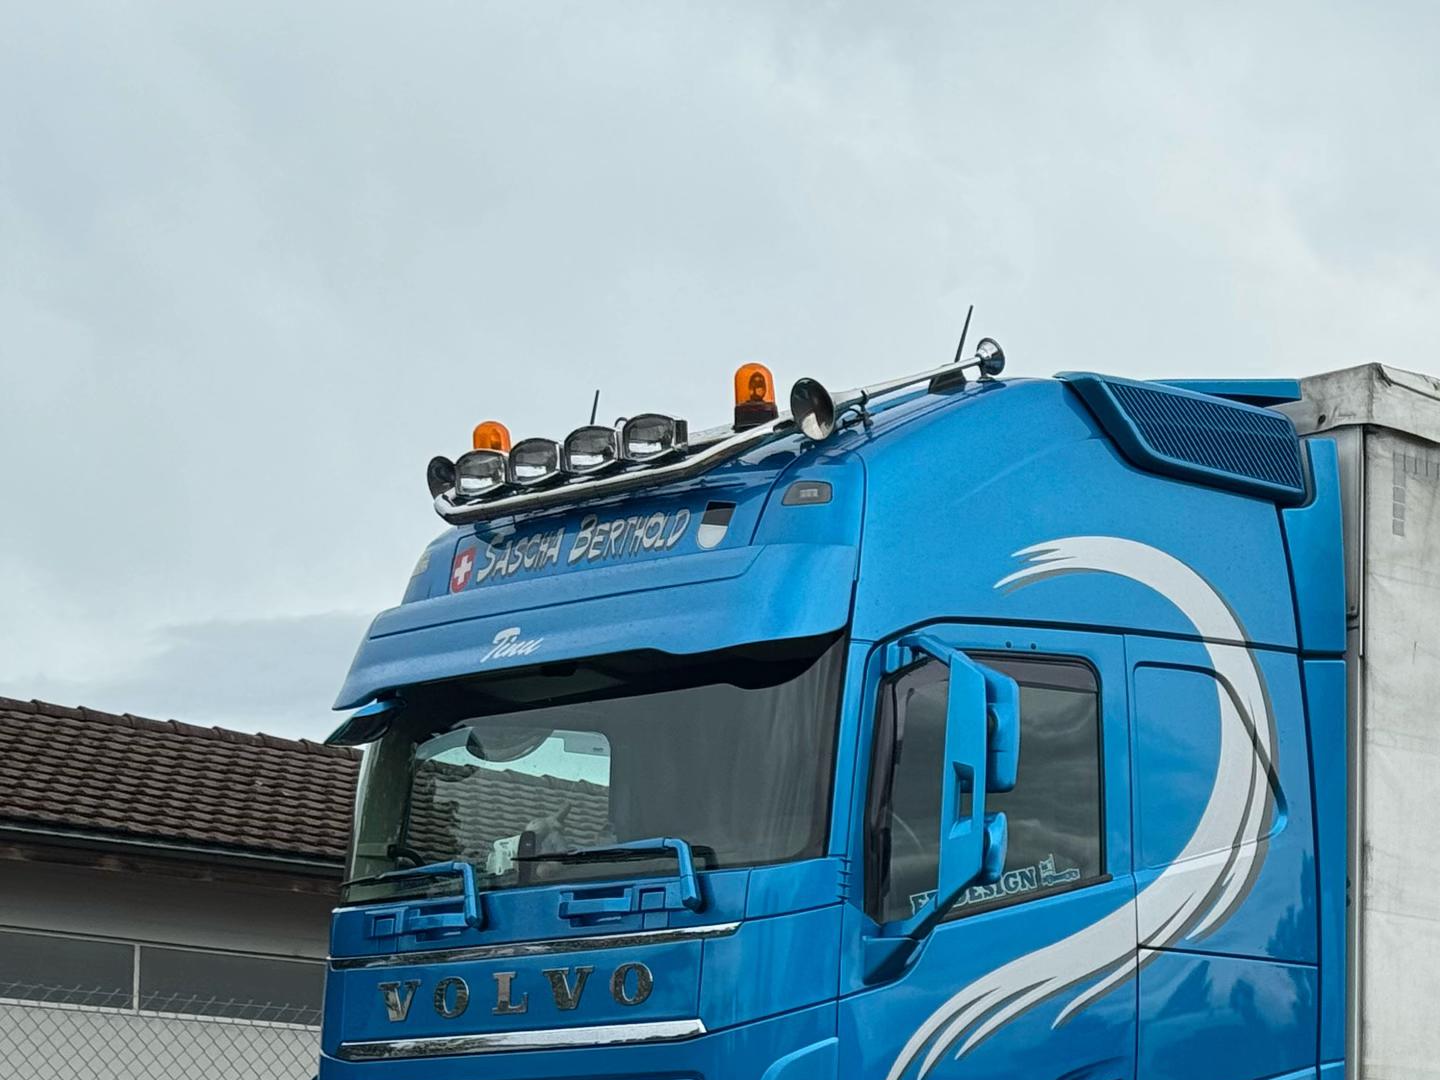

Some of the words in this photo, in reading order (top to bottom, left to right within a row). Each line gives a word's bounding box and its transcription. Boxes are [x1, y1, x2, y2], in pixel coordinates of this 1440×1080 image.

[476, 527, 566, 584] SASCHA
[567, 508, 691, 565] BERTHOLD
[378, 961, 654, 1023] VOLVO
